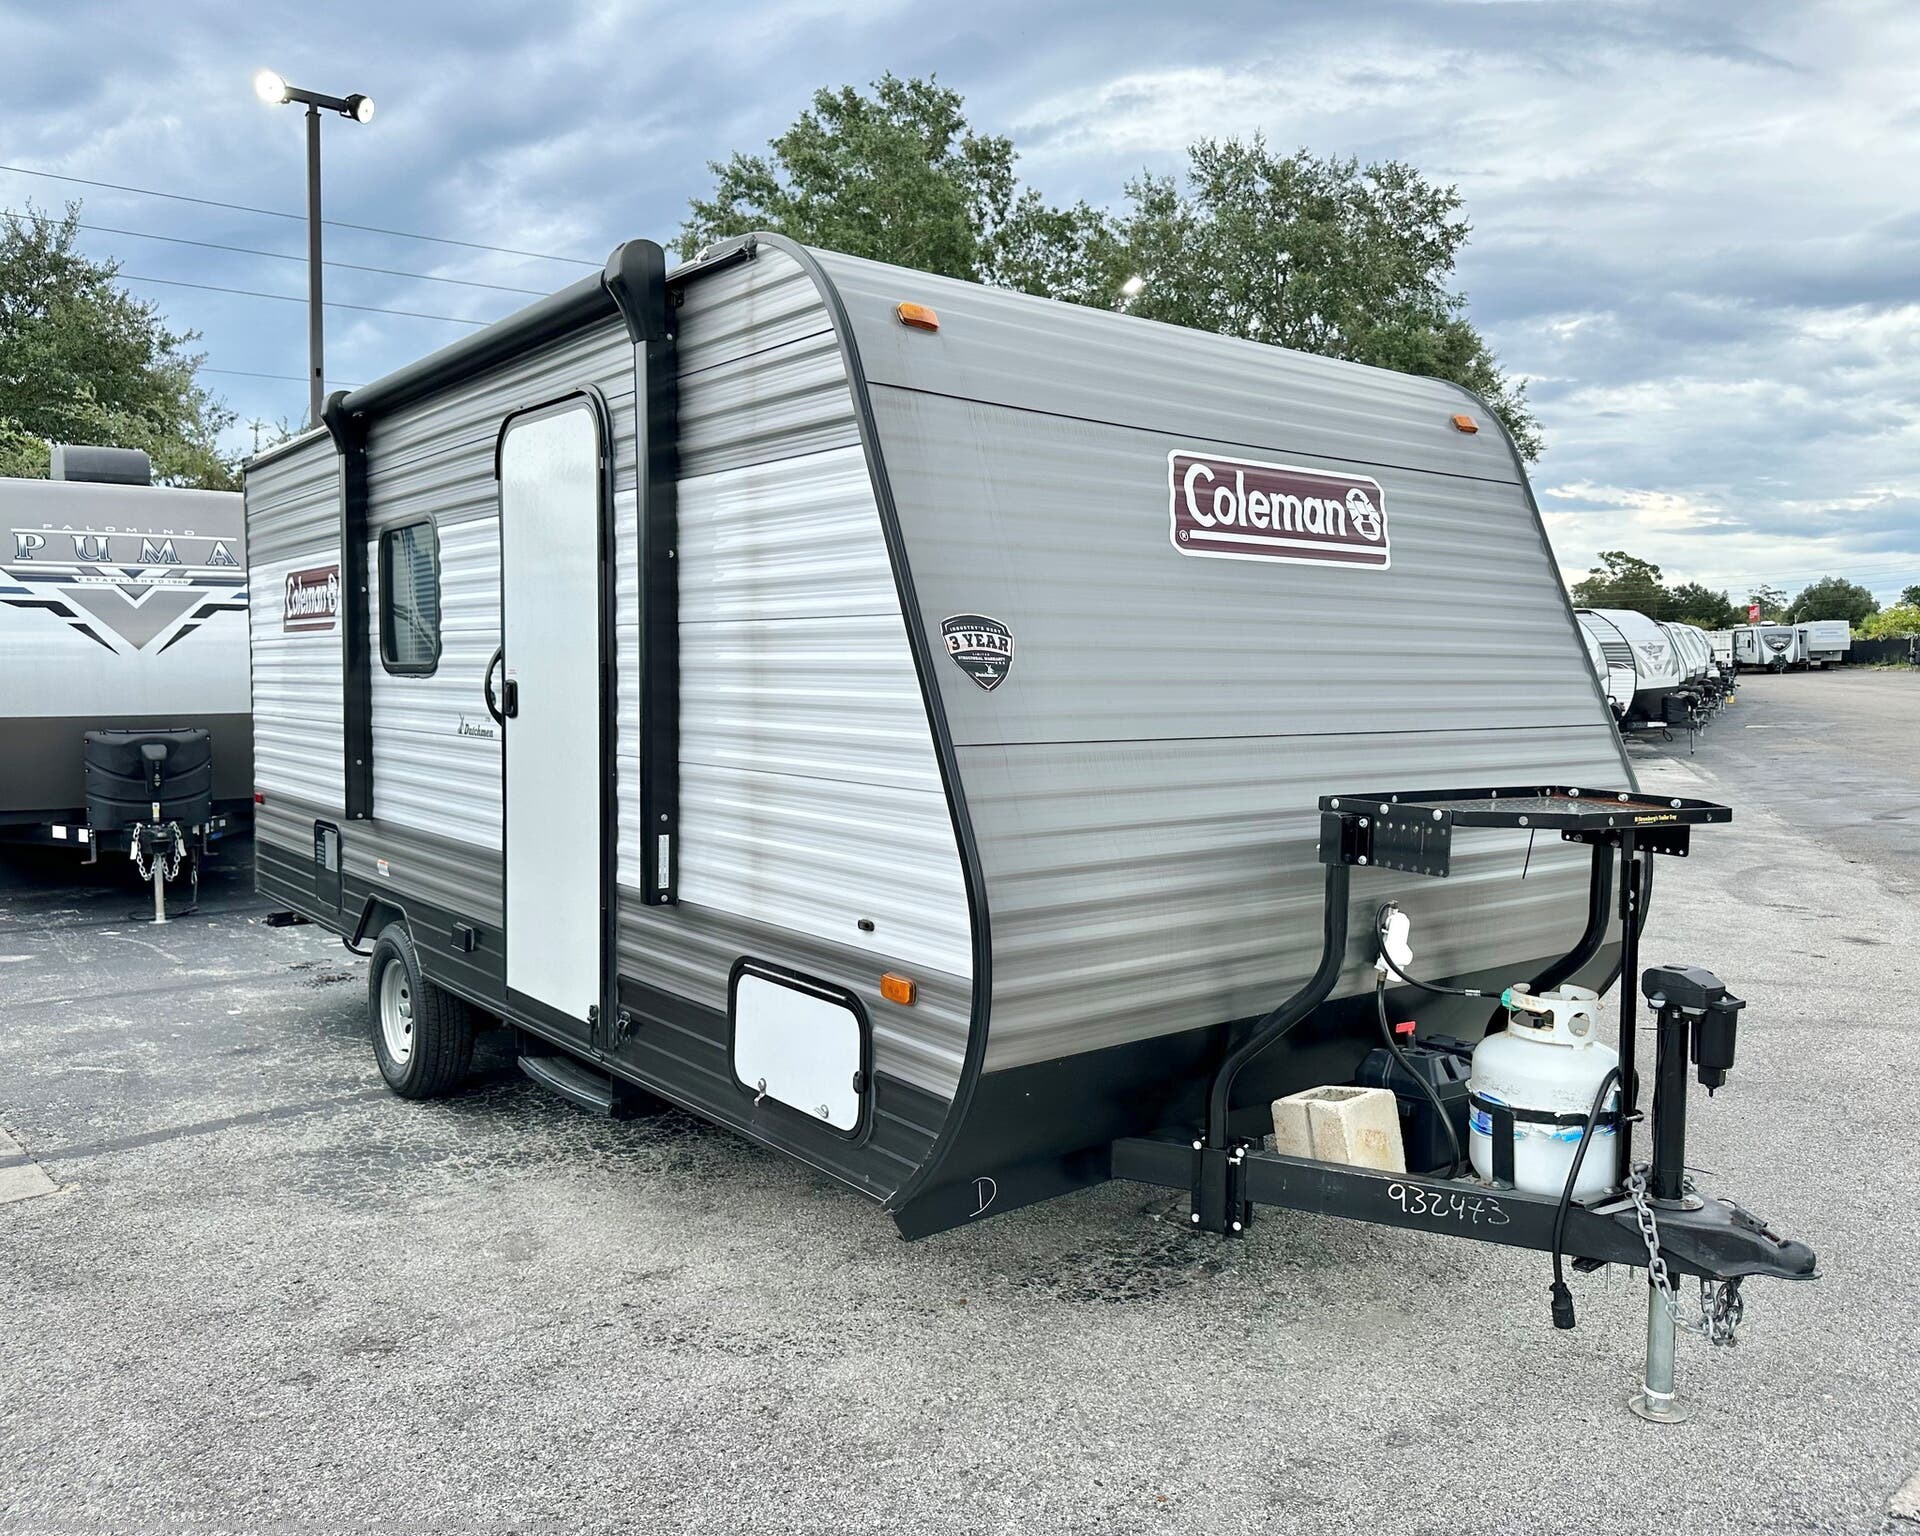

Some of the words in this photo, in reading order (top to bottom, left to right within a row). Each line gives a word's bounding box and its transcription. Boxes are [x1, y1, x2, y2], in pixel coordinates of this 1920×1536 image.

[1183, 462, 1348, 537] Coleman
[43, 523, 195, 536] PALOMINO
[13, 532, 239, 566] PUMA
[286, 573, 328, 619] Coleman
[949, 635, 960, 651] 3
[962, 633, 1009, 652] YEAR
[464, 723, 494, 738] Dutchmen
[969, 1176, 997, 1217] D
[1387, 1183, 1510, 1225] 932473
